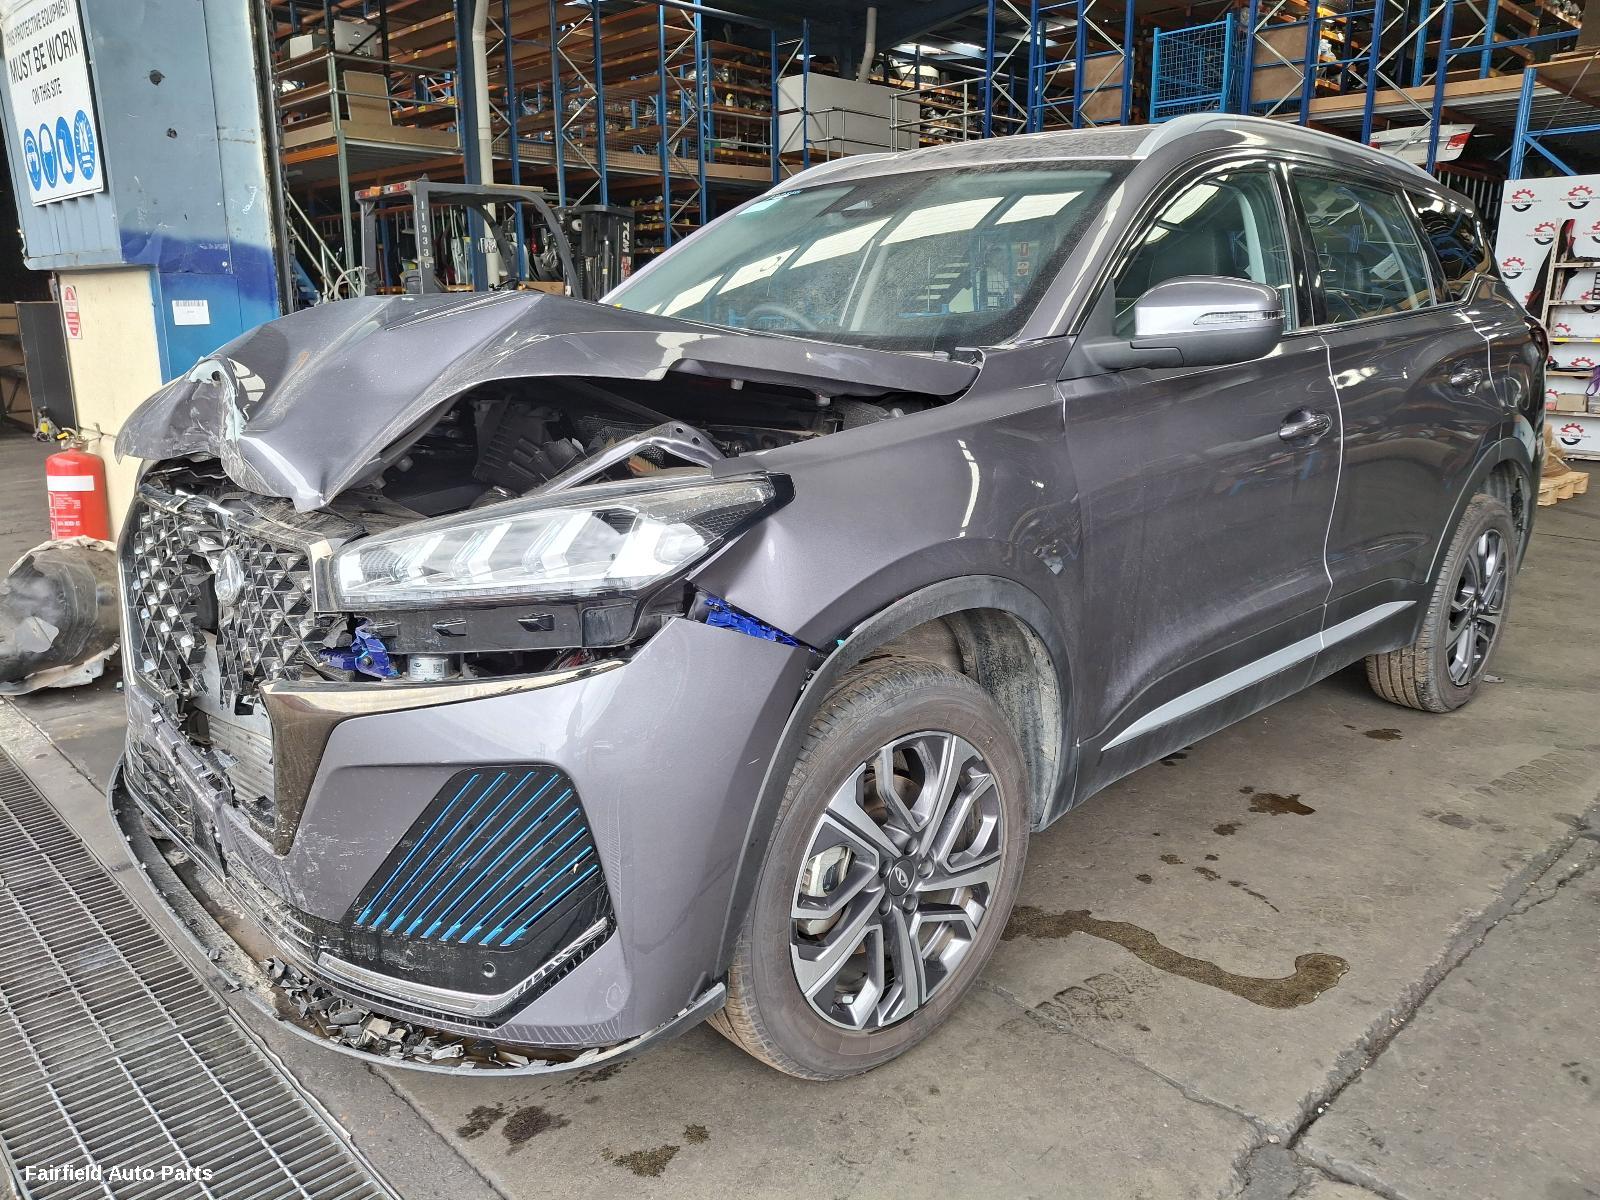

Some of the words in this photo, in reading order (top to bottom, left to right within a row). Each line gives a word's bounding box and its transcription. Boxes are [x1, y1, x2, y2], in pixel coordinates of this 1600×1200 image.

[14, 12, 42, 44] PROTECTIVE
[41, 0, 70, 28] EQUIPMENT
[9, 49, 33, 84] MUST
[33, 42, 48, 73] BE
[45, 25, 79, 66] WORN
[32, 88, 41, 105] ON
[39, 82, 52, 101] THIS
[50, 77, 63, 97] SITE
[622, 221, 630, 253] TCM
